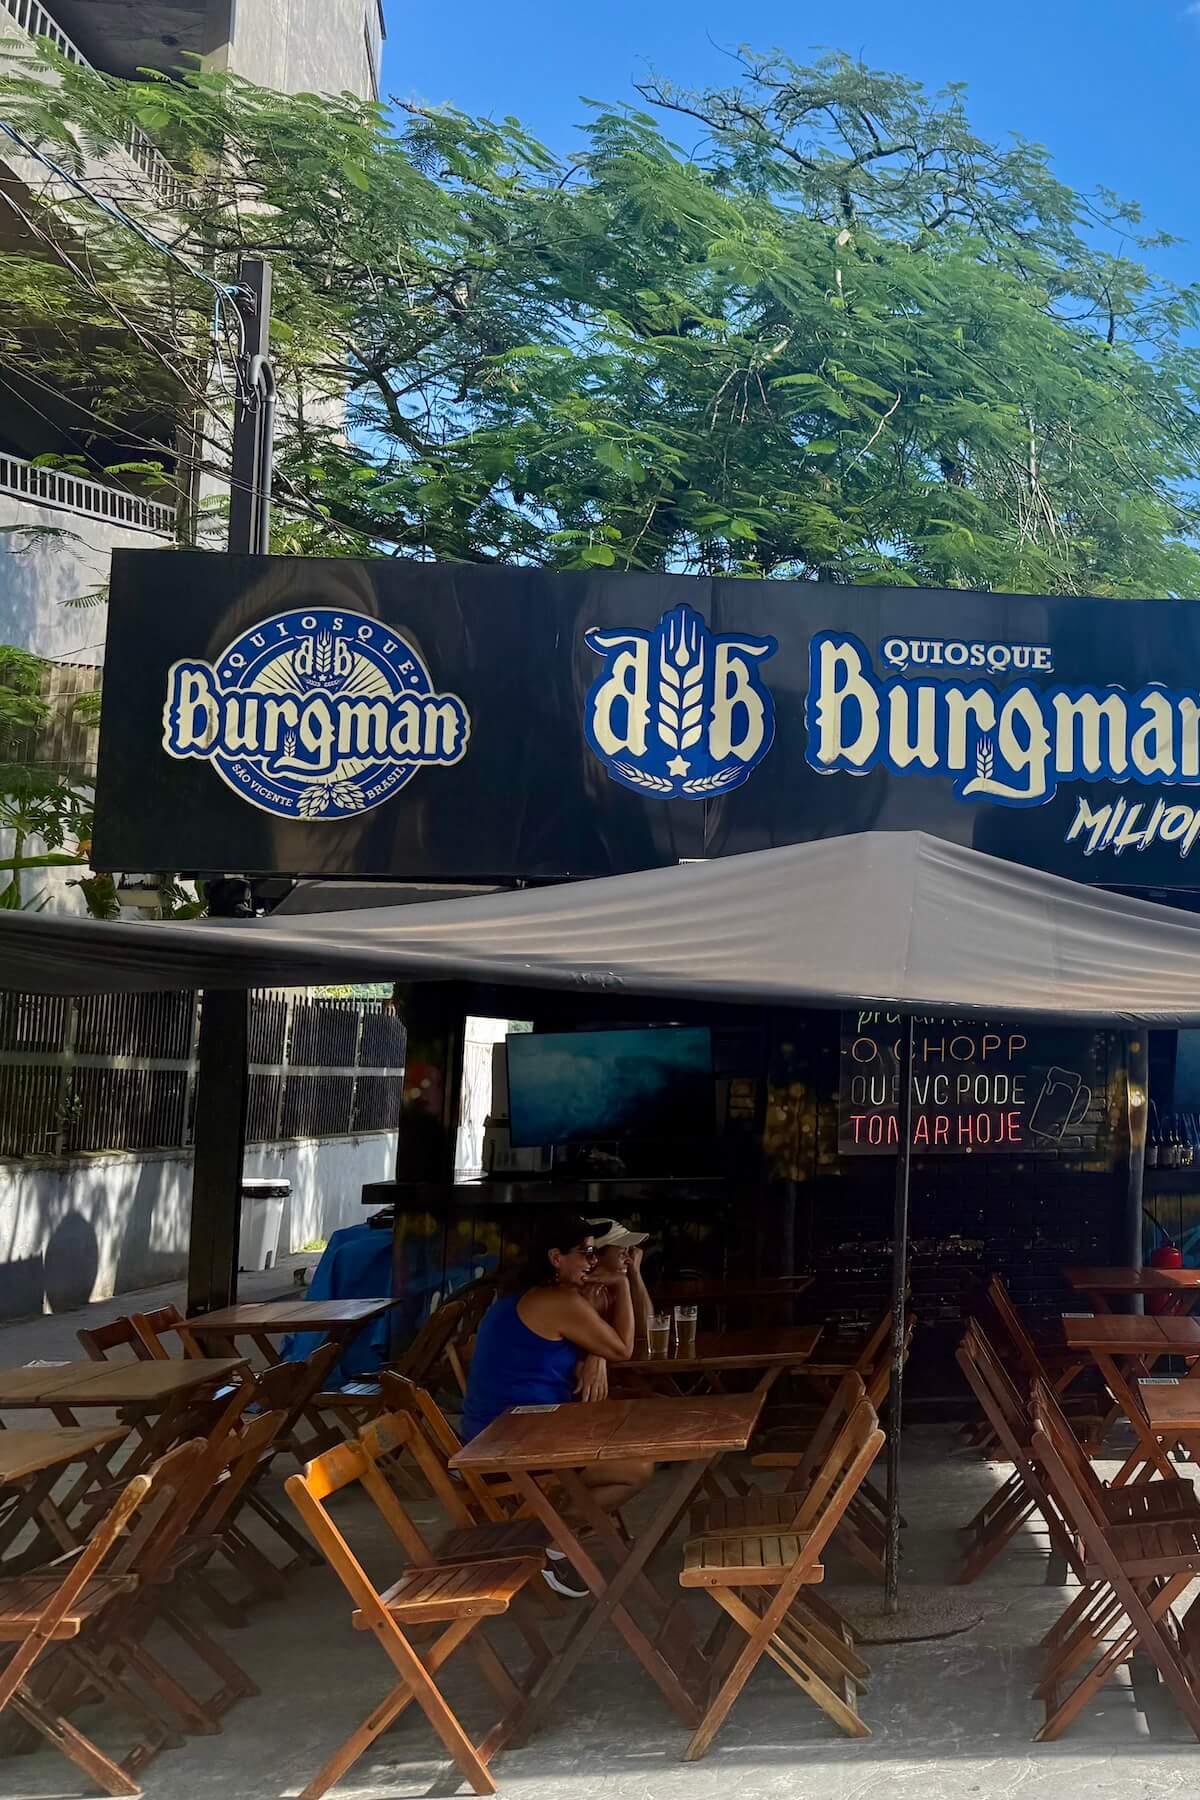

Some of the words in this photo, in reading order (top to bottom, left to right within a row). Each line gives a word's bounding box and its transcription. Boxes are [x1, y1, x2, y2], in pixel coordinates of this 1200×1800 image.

[228, 616, 413, 676] QUIOSQUE
[884, 638, 1053, 674] QUIOSQUE
[176, 669, 459, 771] Burgman
[250, 780, 294, 807] VICENTE
[365, 767, 407, 800] BRASIL
[852, 1037, 878, 1063] O
[913, 1075, 949, 1105] VC
[956, 1074, 1027, 1105] PODE
[958, 1111, 1023, 1145] HOJE
